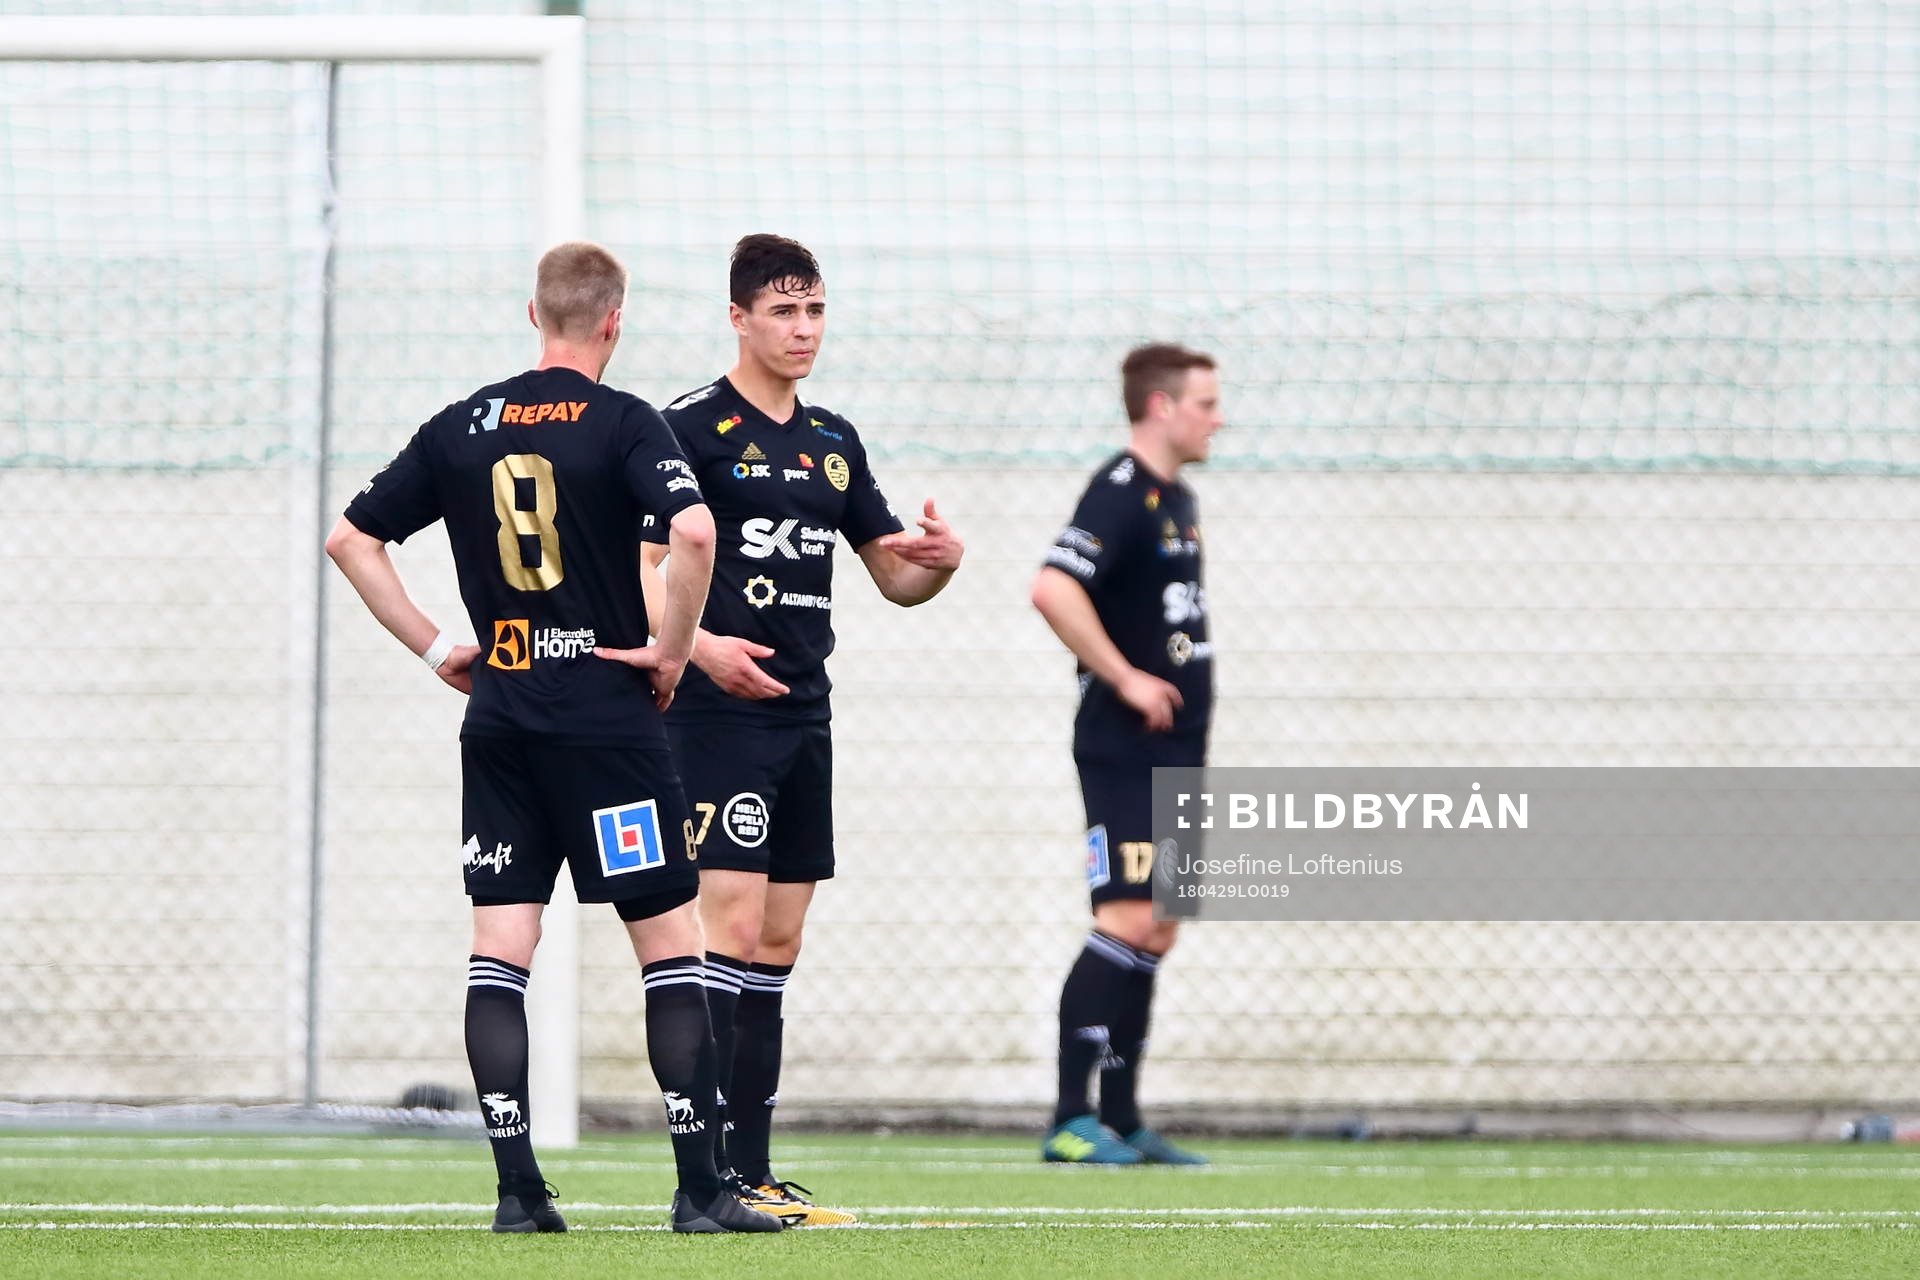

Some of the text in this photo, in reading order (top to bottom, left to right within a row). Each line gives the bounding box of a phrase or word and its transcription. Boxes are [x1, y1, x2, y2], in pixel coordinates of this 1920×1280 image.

[502, 401, 588, 424] REPAY
[783, 468, 810, 482] pwc
[491, 453, 565, 592] 8
[739, 517, 801, 560] SK
[801, 542, 826, 556] Kraft
[534, 628, 596, 660] Home
[683, 818, 698, 861] 8
[694, 802, 717, 846] 7
